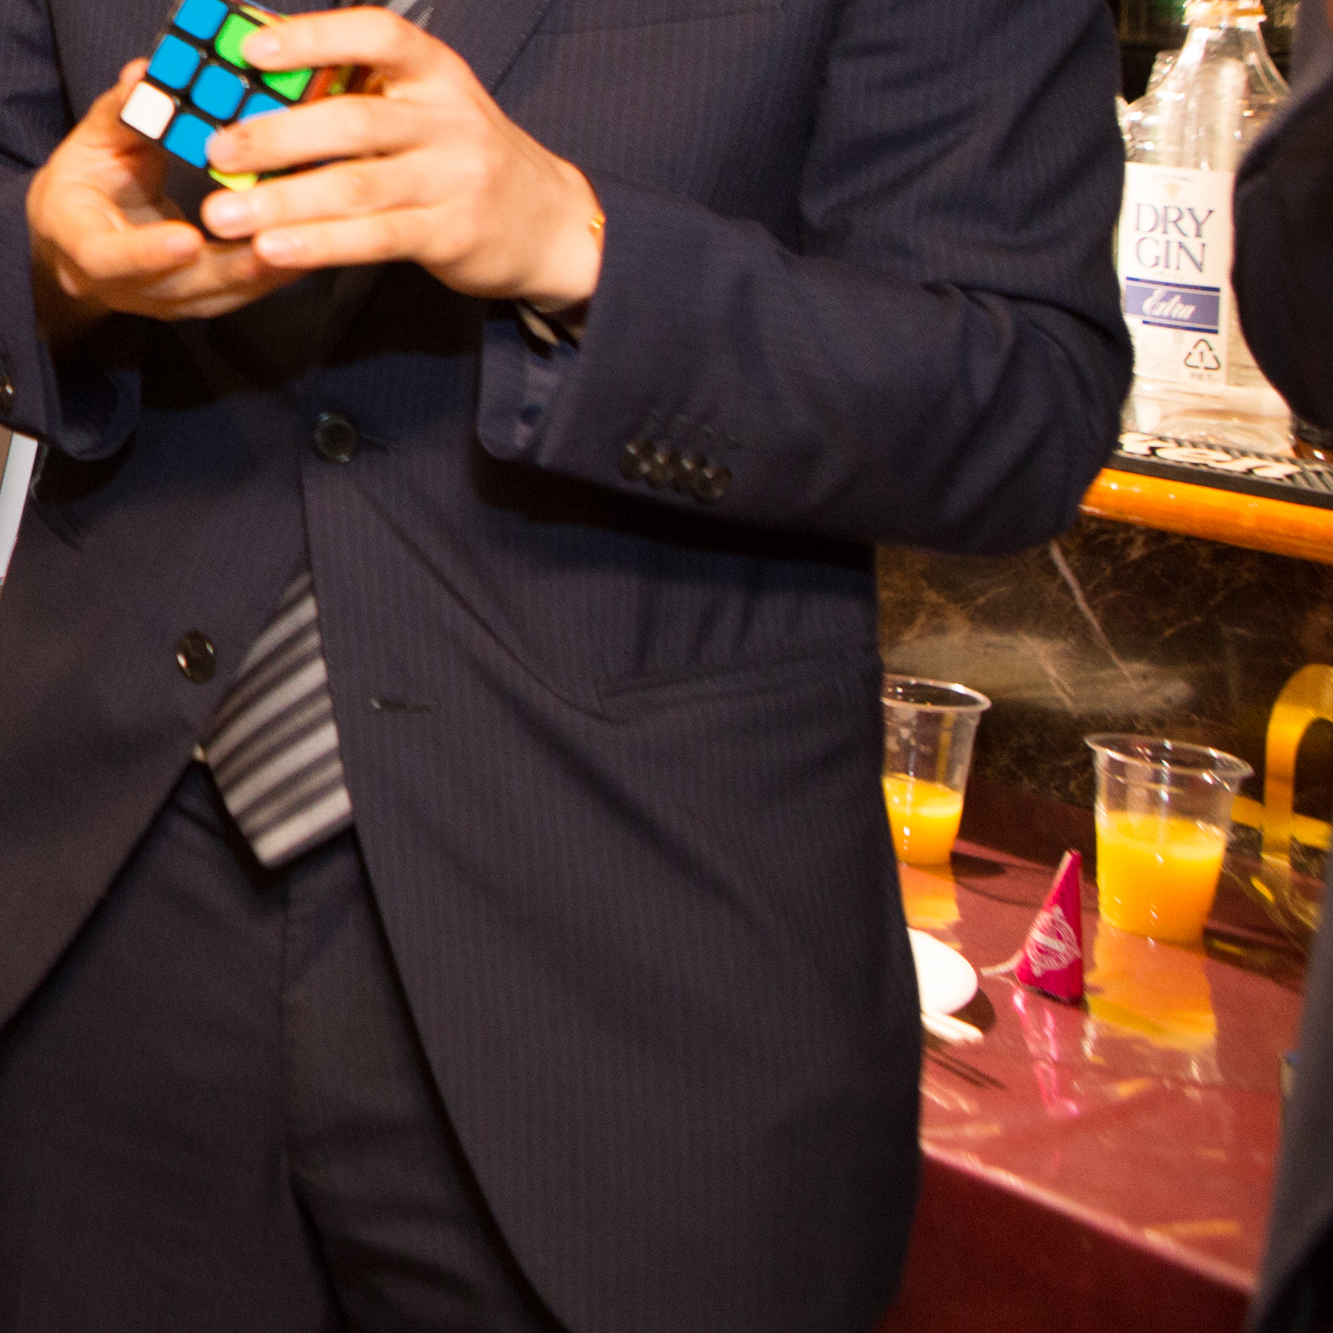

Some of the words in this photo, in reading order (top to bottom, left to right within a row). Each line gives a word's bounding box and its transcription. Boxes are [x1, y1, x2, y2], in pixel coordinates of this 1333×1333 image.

[1135, 203, 1214, 238] DRY
[1135, 237, 1206, 273] GIN
[1142, 288, 1196, 320] Extra
